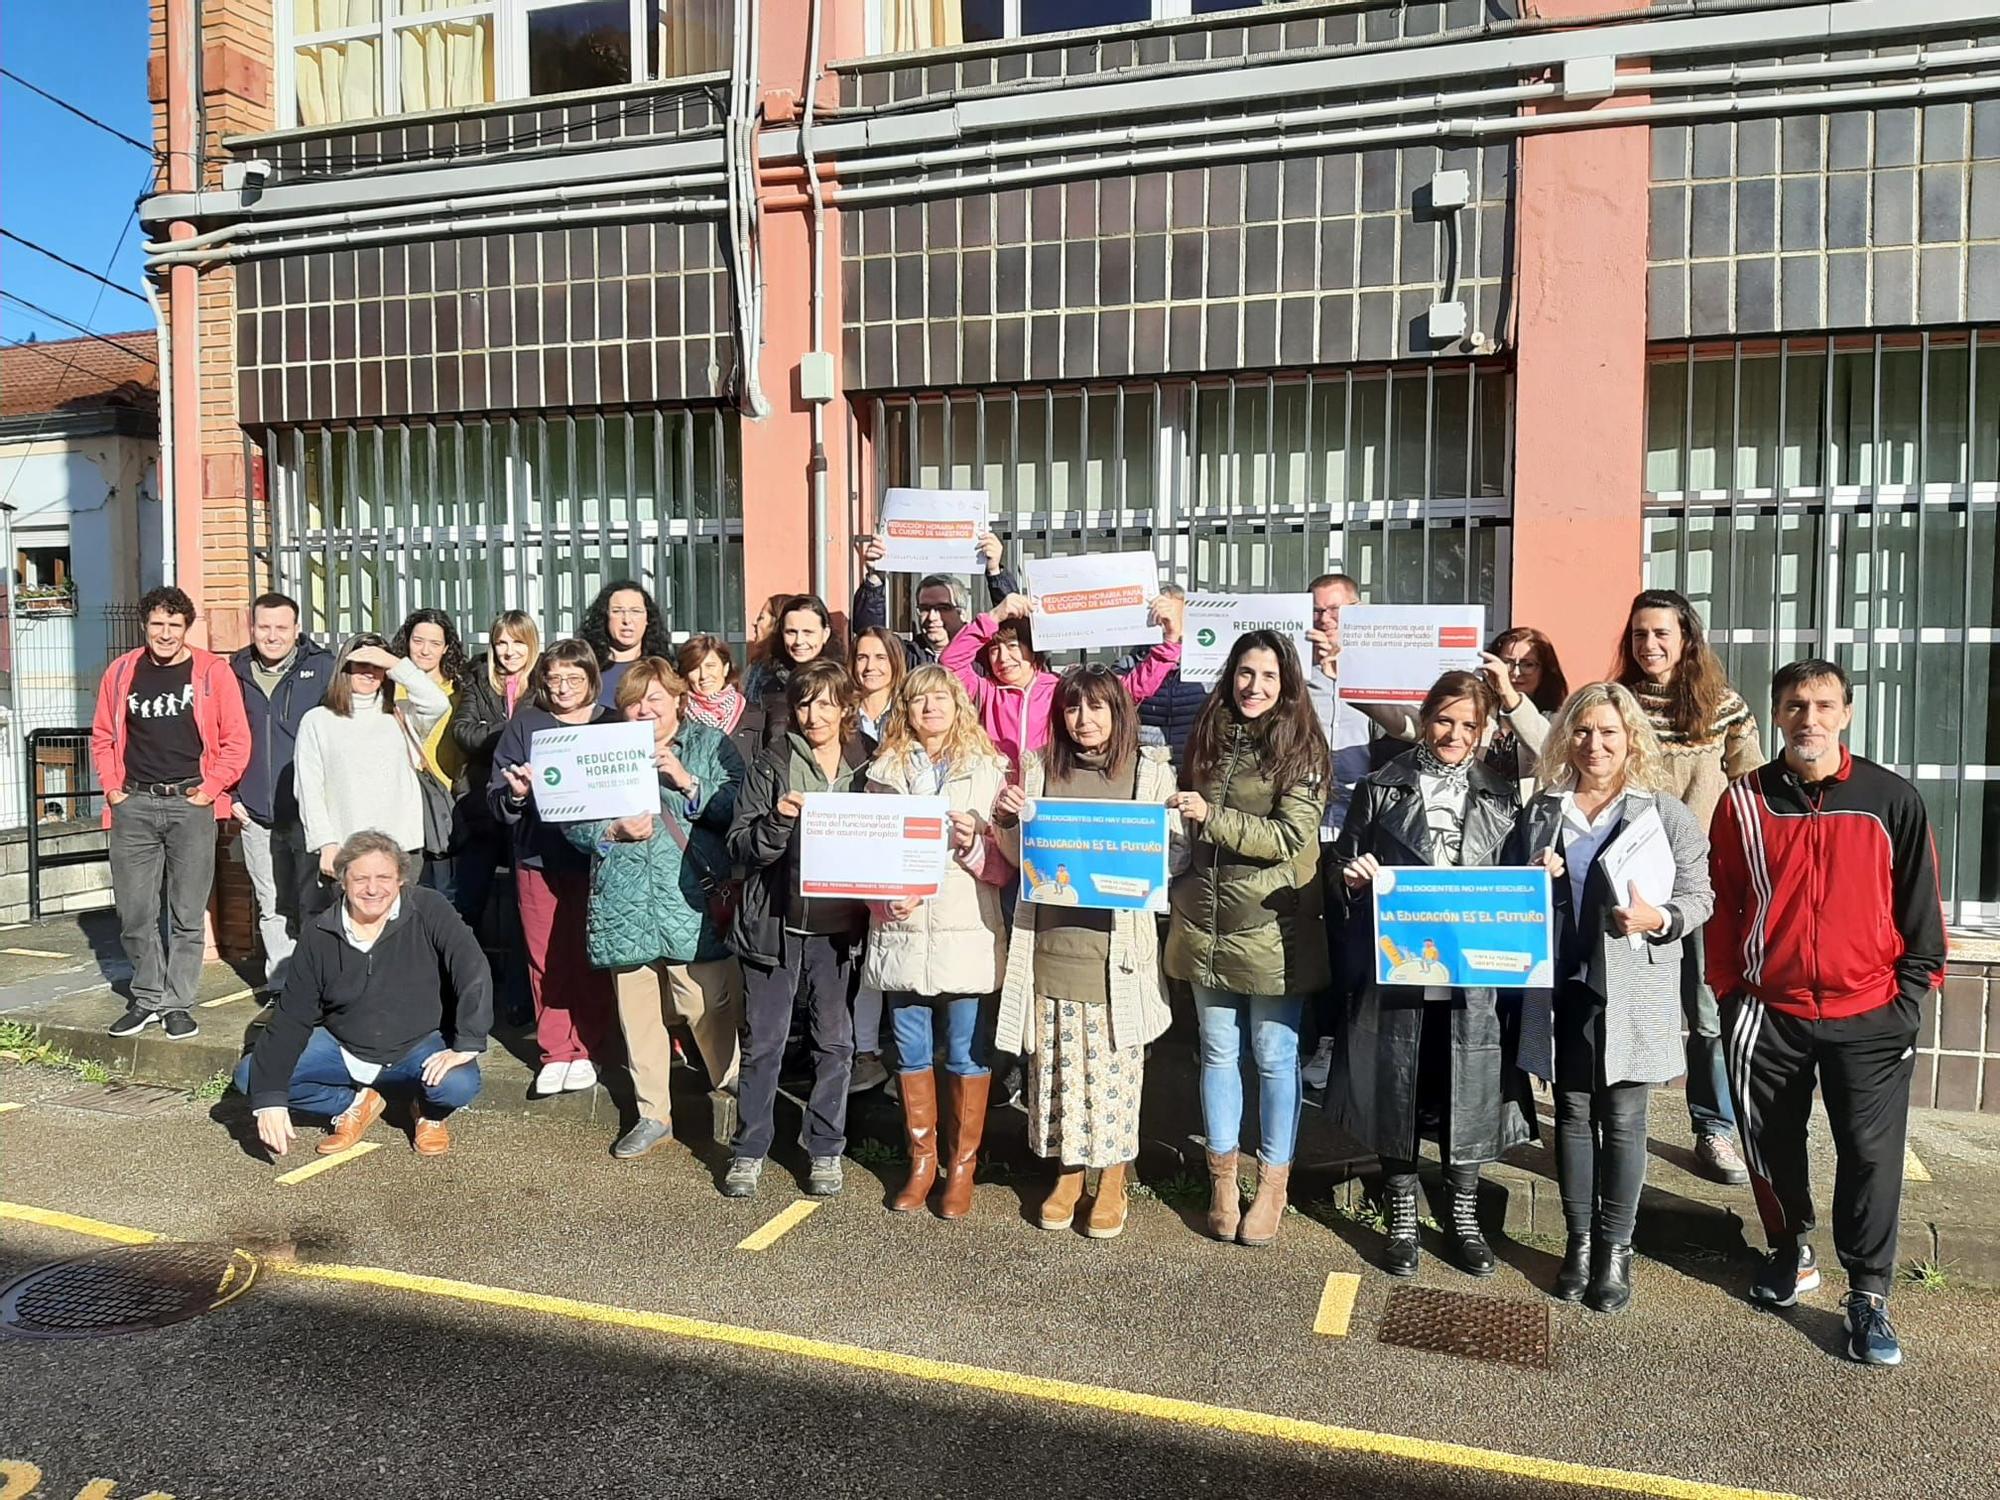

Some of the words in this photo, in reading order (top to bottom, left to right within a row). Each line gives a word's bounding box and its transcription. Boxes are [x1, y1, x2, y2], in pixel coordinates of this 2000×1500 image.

[1088, 591, 1122, 600] HORARIA
[1057, 602, 1087, 610] CUERPO
[1099, 597, 1138, 607] MAESTROS
[1233, 619, 1304, 631] REDUCCIÓN
[1373, 624, 1409, 633] permisos
[1409, 625, 1425, 634] que
[1363, 631, 1376, 639] del
[576, 748, 646, 765] REDUCCIÓN
[585, 762, 638, 776] HORARIA
[838, 812, 874, 822] permisos
[875, 814, 890, 823] que
[891, 813, 900, 821] el
[1052, 815, 1092, 823] DOCENTES
[1105, 816, 1121, 824] HAY
[1121, 817, 1156, 825] ESCUELA
[868, 831, 898, 840] propios
[1024, 836, 1035, 847] LA
[1036, 836, 1090, 850] EDUCACIÓN
[1106, 839, 1118, 851] EL
[1397, 884, 1412, 892] SIN
[1413, 884, 1460, 893] DOCENTES
[1475, 885, 1494, 893] HAY
[1495, 885, 1535, 893] ESCUELA
[1380, 911, 1394, 922] LA
[1396, 908, 1459, 923] EDUCACIÓN
[1478, 911, 1493, 923] EL
